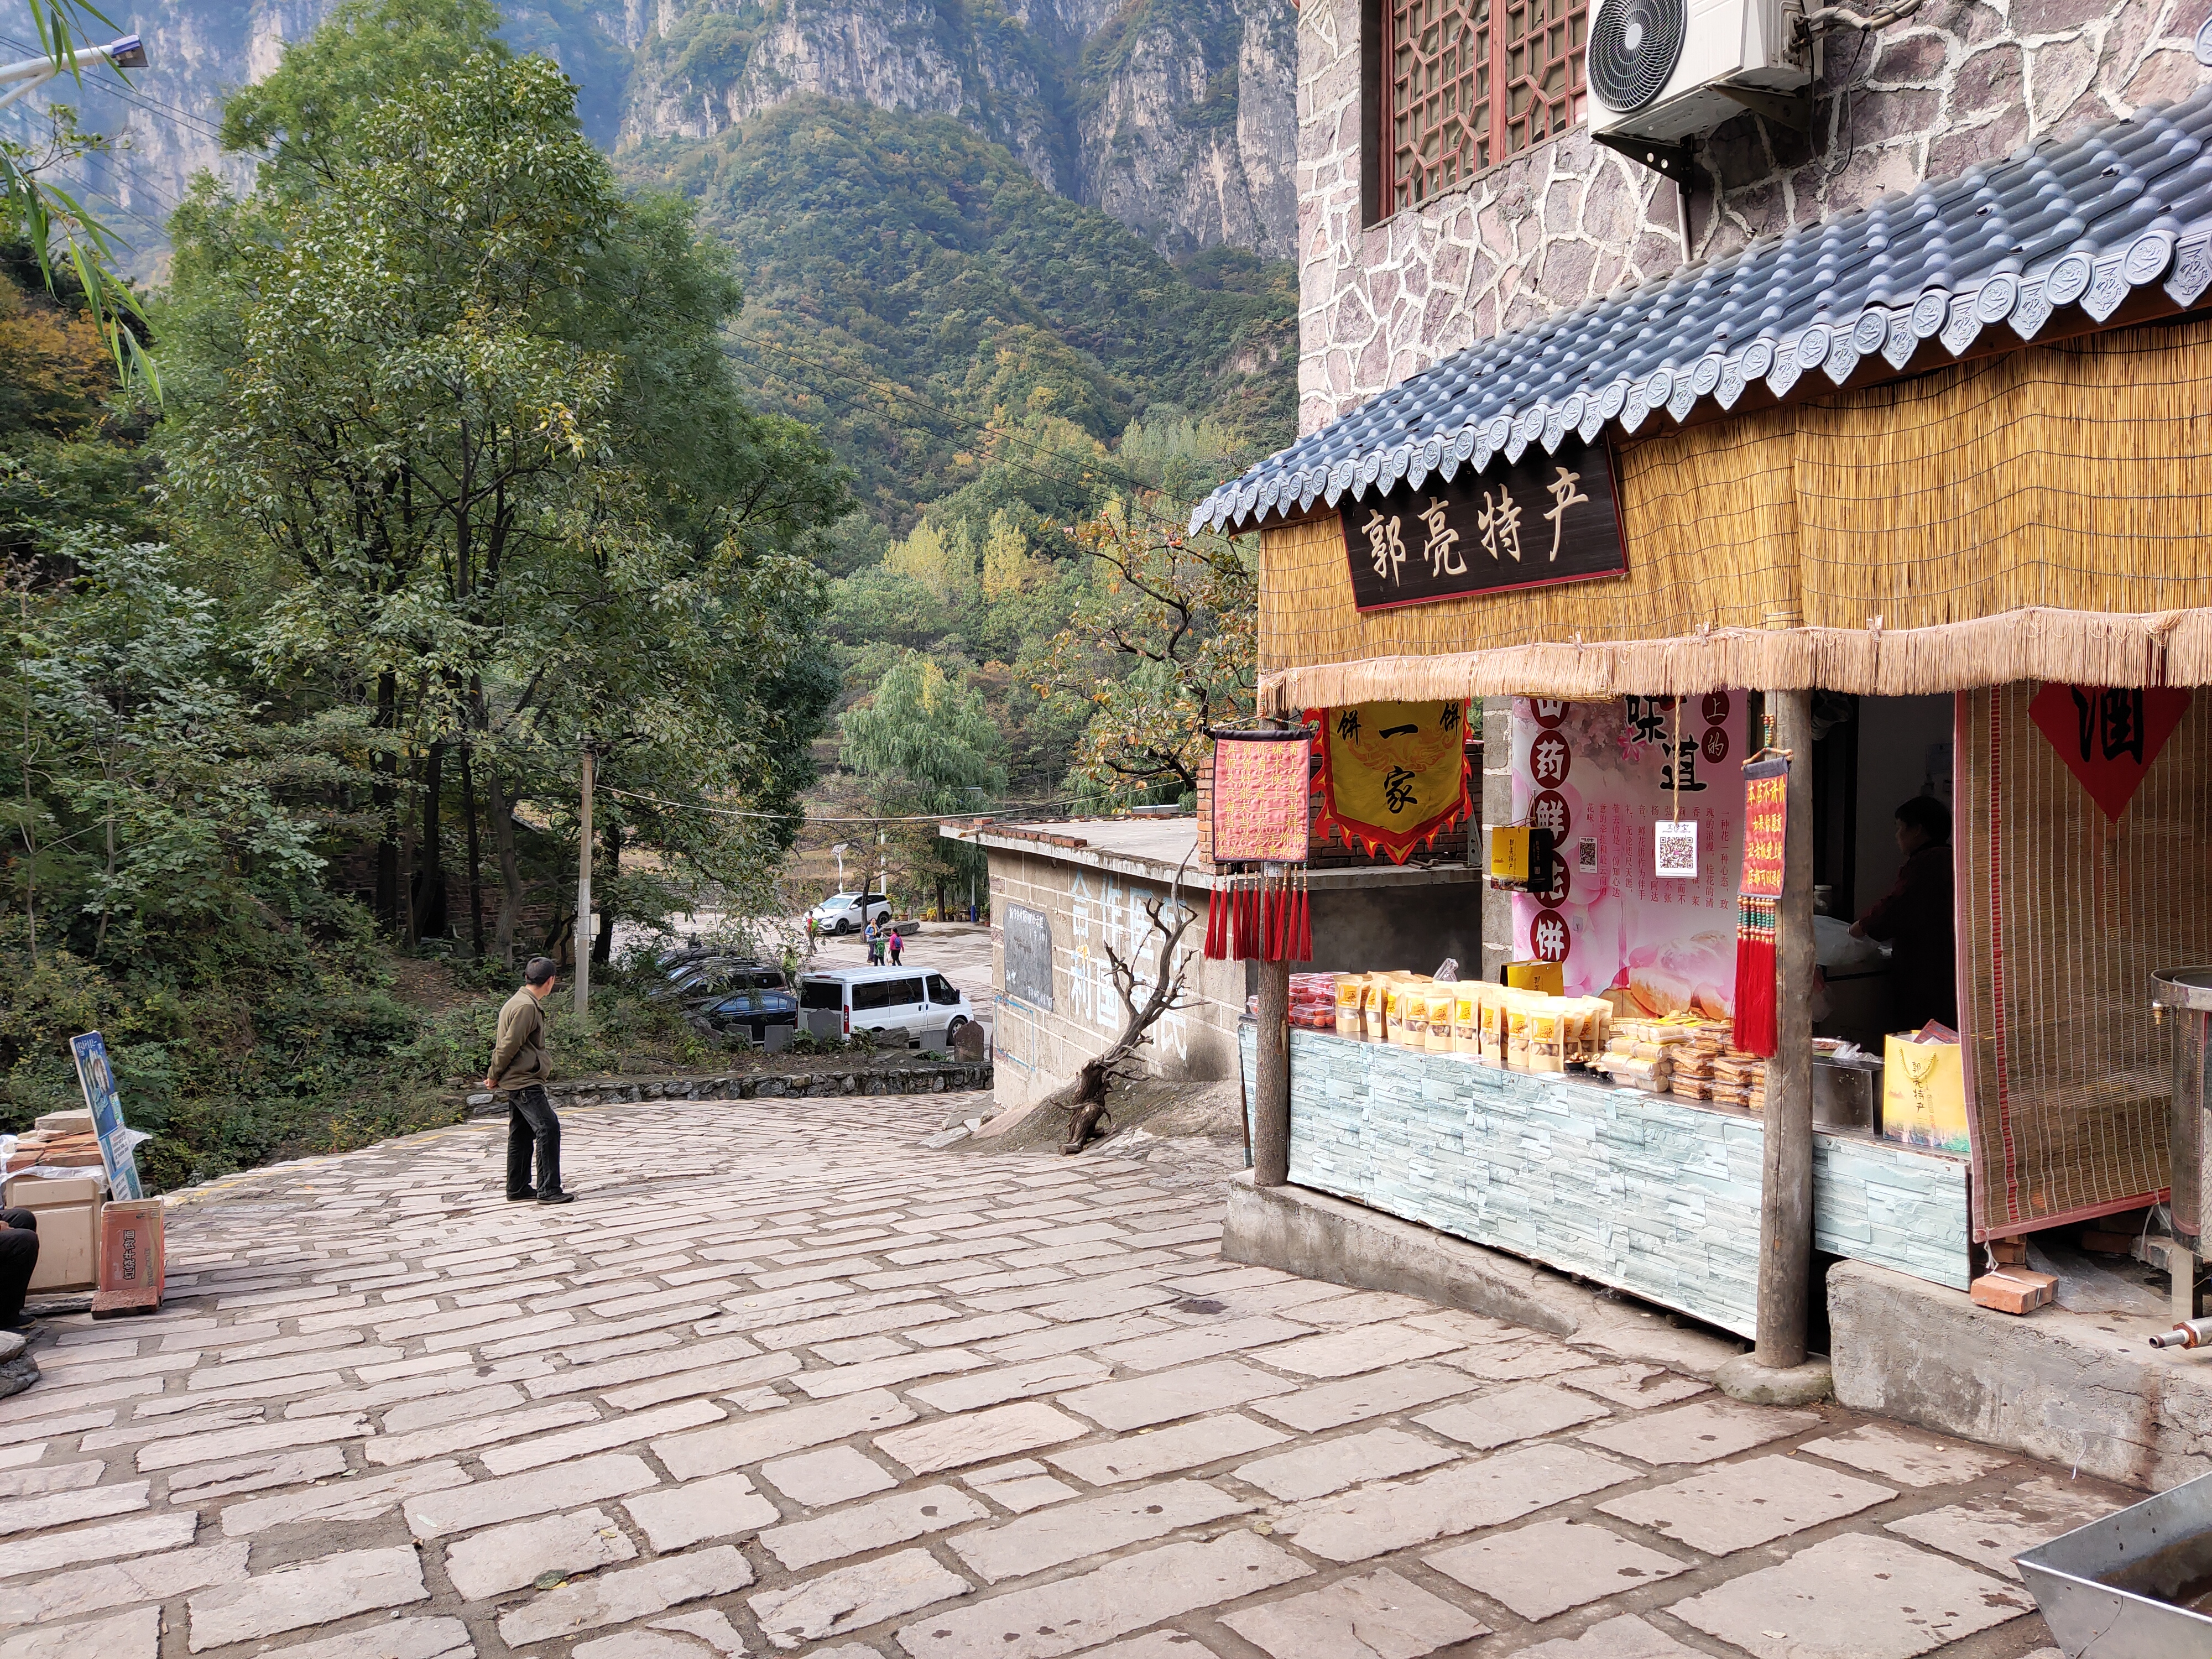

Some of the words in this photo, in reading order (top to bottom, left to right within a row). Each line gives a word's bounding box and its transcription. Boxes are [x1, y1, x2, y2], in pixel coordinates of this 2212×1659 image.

[1361, 466, 1589, 588] 郭亮特产
[1224, 741, 1301, 757] 真货你嫌贵
[1223, 758, 1302, 773] 假货看不上
[1222, 773, 1300, 786] 又好又便宜
[1222, 786, 1300, 801] 只能是上当
[1746, 776, 1786, 806] 本店不讲价
[1223, 800, 1298, 815] 每天上一当
[1223, 815, 1301, 831] 当当不一样
[1216, 845, 1306, 857] 不关注质量的人
[123, 1229, 136, 1281] 红烧牛肉面
